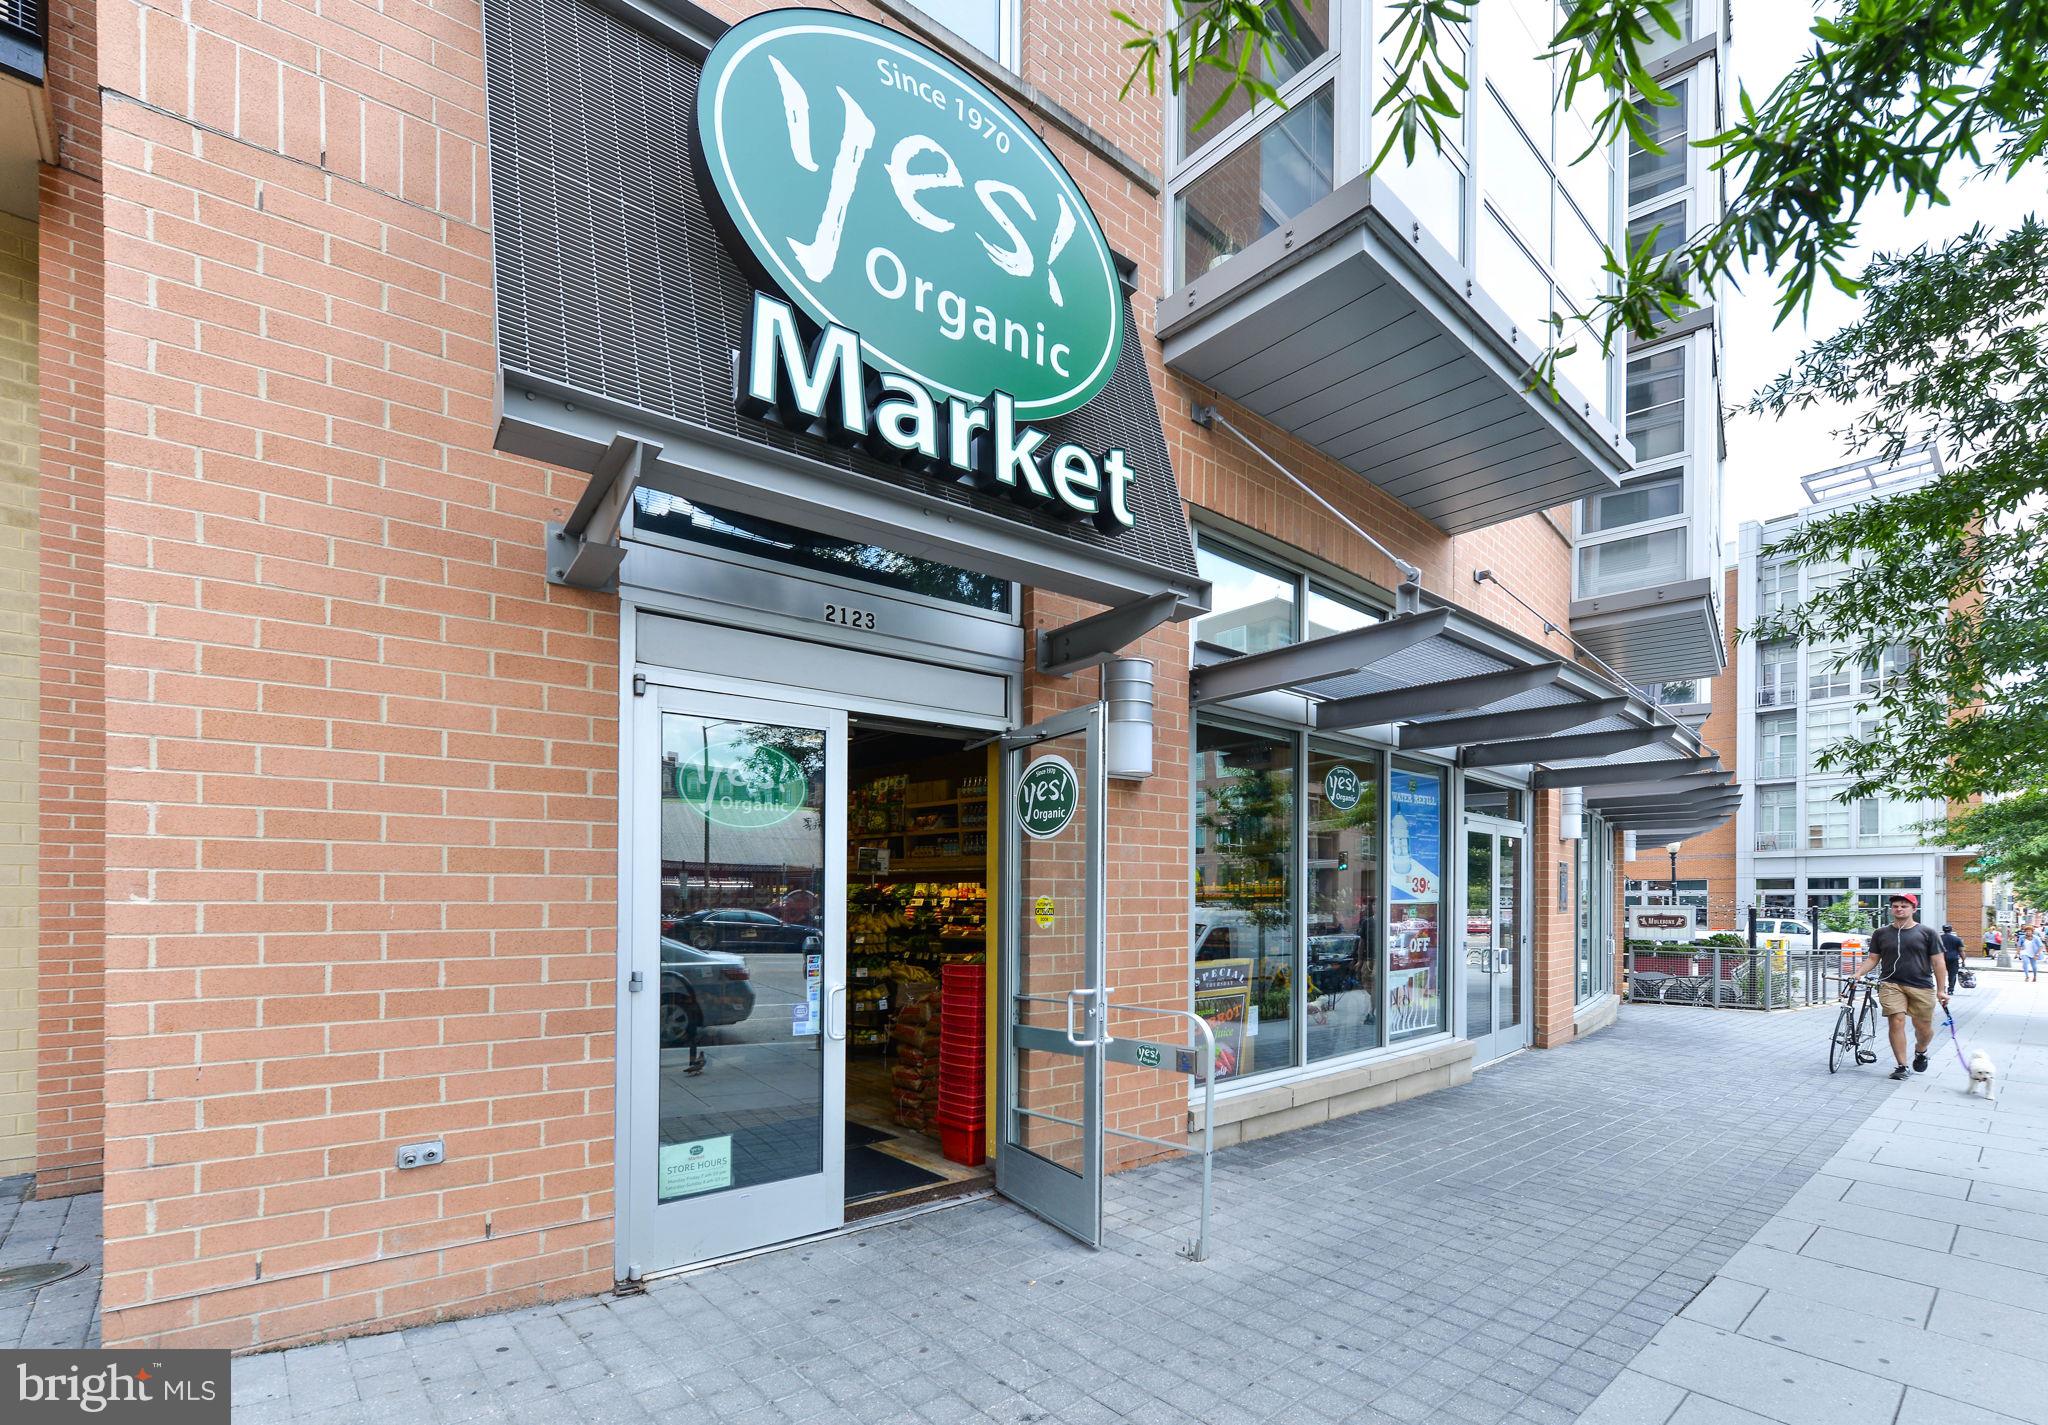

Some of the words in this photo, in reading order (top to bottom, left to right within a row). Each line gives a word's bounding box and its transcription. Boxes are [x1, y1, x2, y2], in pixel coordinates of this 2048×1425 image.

[877, 58, 946, 111] Since
[955, 98, 1010, 154] 1970
[769, 55, 1076, 307] yes!
[865, 247, 1070, 378] Organic
[750, 291, 1136, 527] Market
[825, 604, 875, 629] 2123
[1023, 773, 1068, 823] yes!
[1329, 775, 1356, 801] yes!
[1391, 791, 1413, 803] WATER
[1414, 795, 1437, 806] REFILL
[720, 796, 788, 814] Organic
[1033, 807, 1066, 821] Organic
[1409, 937, 1431, 953] OFF
[1195, 967, 1245, 987] SPECIAL
[1139, 1047, 1158, 1061] yes!
[667, 1163, 695, 1175] STORE
[697, 1157, 728, 1169] HOURS
